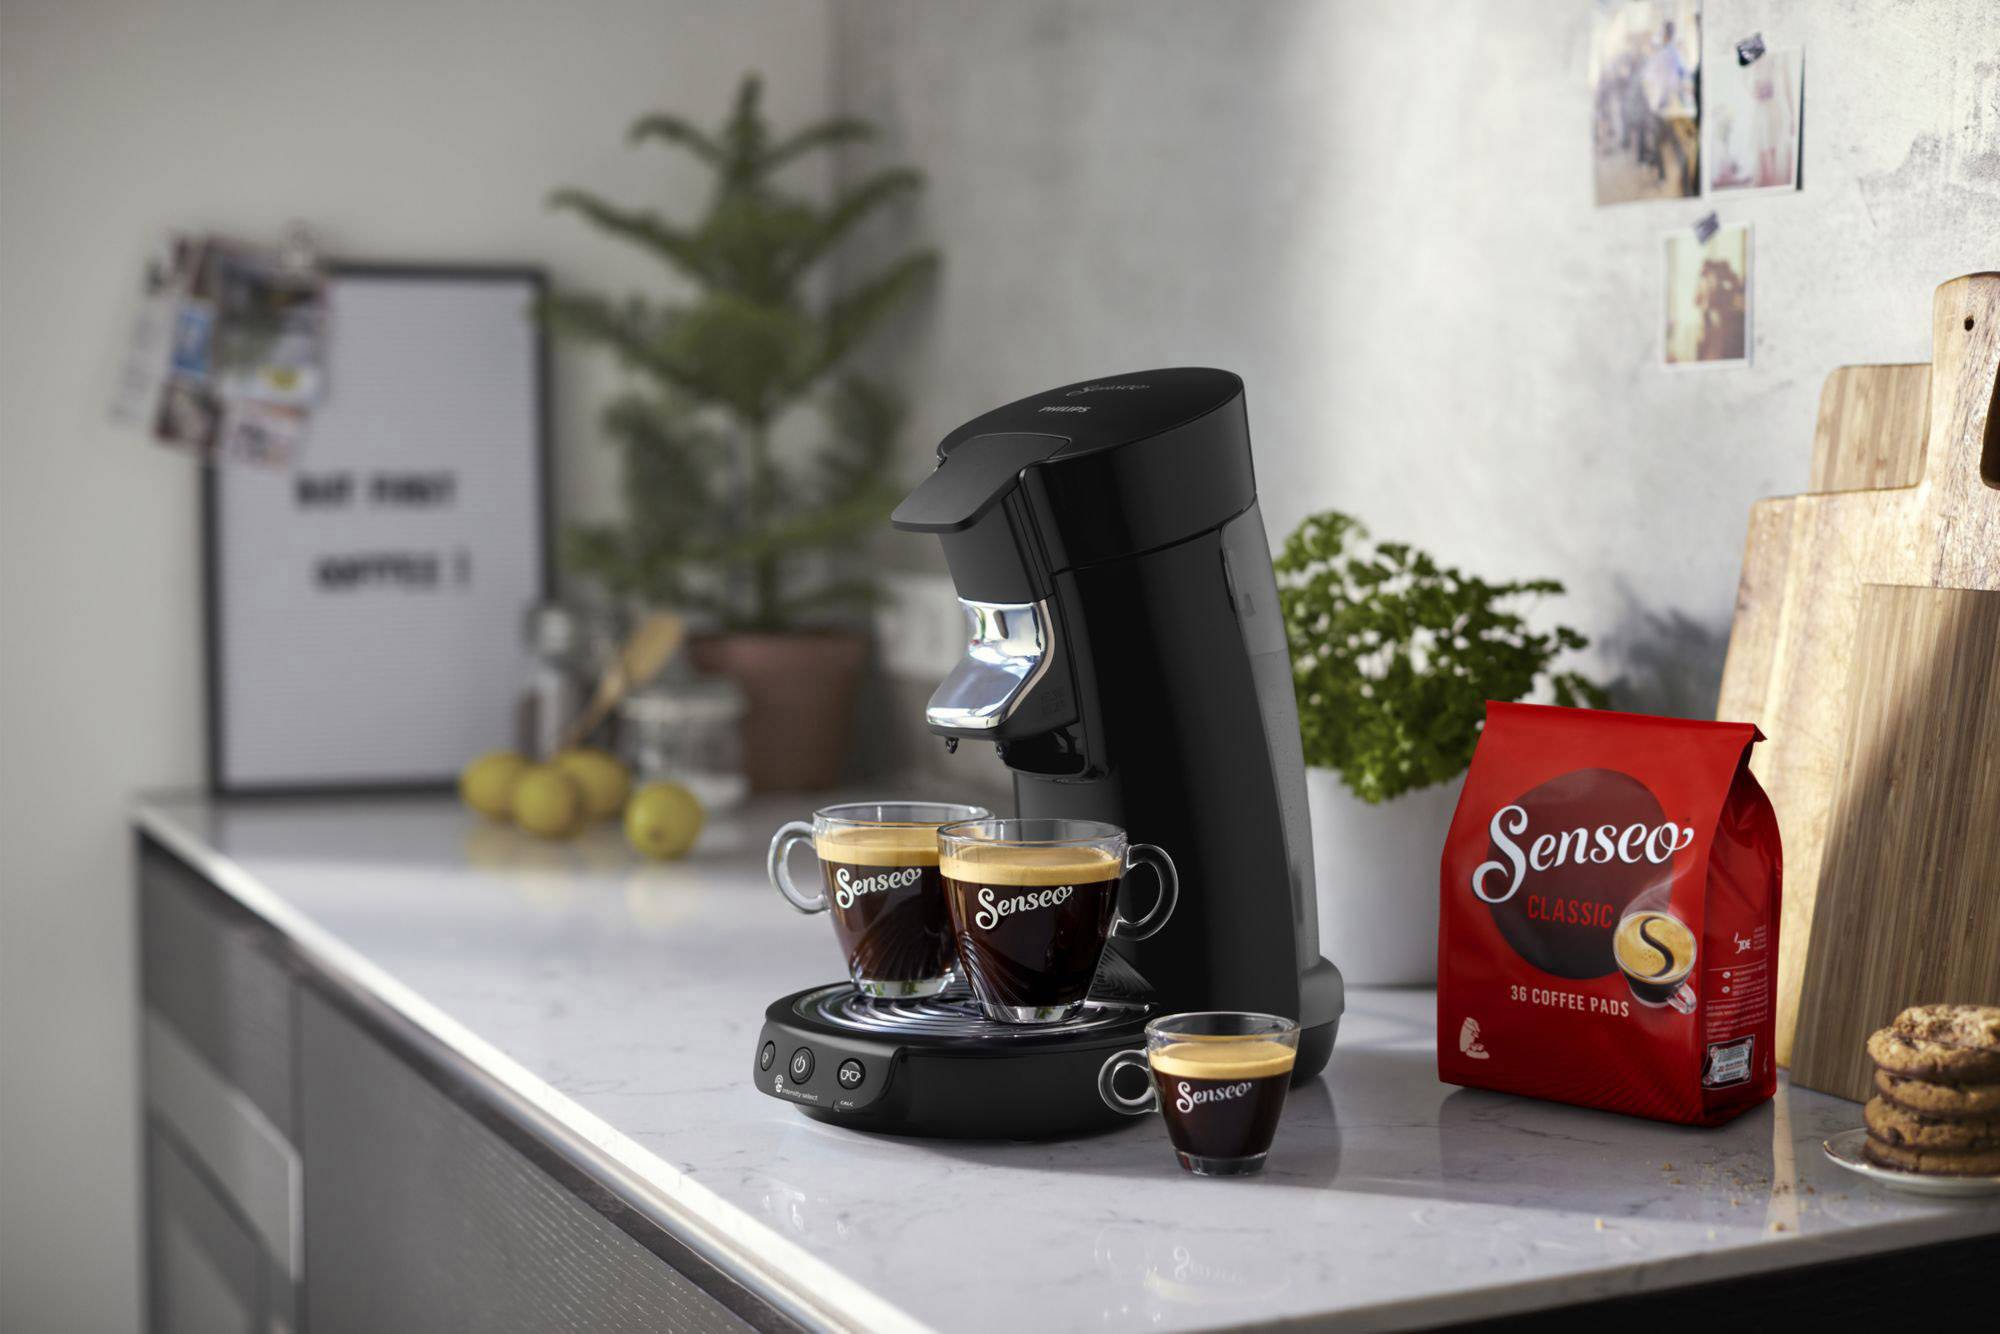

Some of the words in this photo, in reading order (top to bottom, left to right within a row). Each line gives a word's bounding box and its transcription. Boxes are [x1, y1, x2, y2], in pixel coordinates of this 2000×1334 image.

[1038, 405, 1091, 413] PHILIPS
[1471, 804, 1694, 905] Senseo
[835, 866, 922, 910] Senseo
[975, 885, 1073, 931] Senseo
[1527, 895, 1614, 929] CLASSIC
[1510, 985, 1528, 1004] 36
[1531, 988, 1585, 1013] COFFEE
[1589, 995, 1630, 1018] PADS
[1176, 1081, 1252, 1114] Senseo
